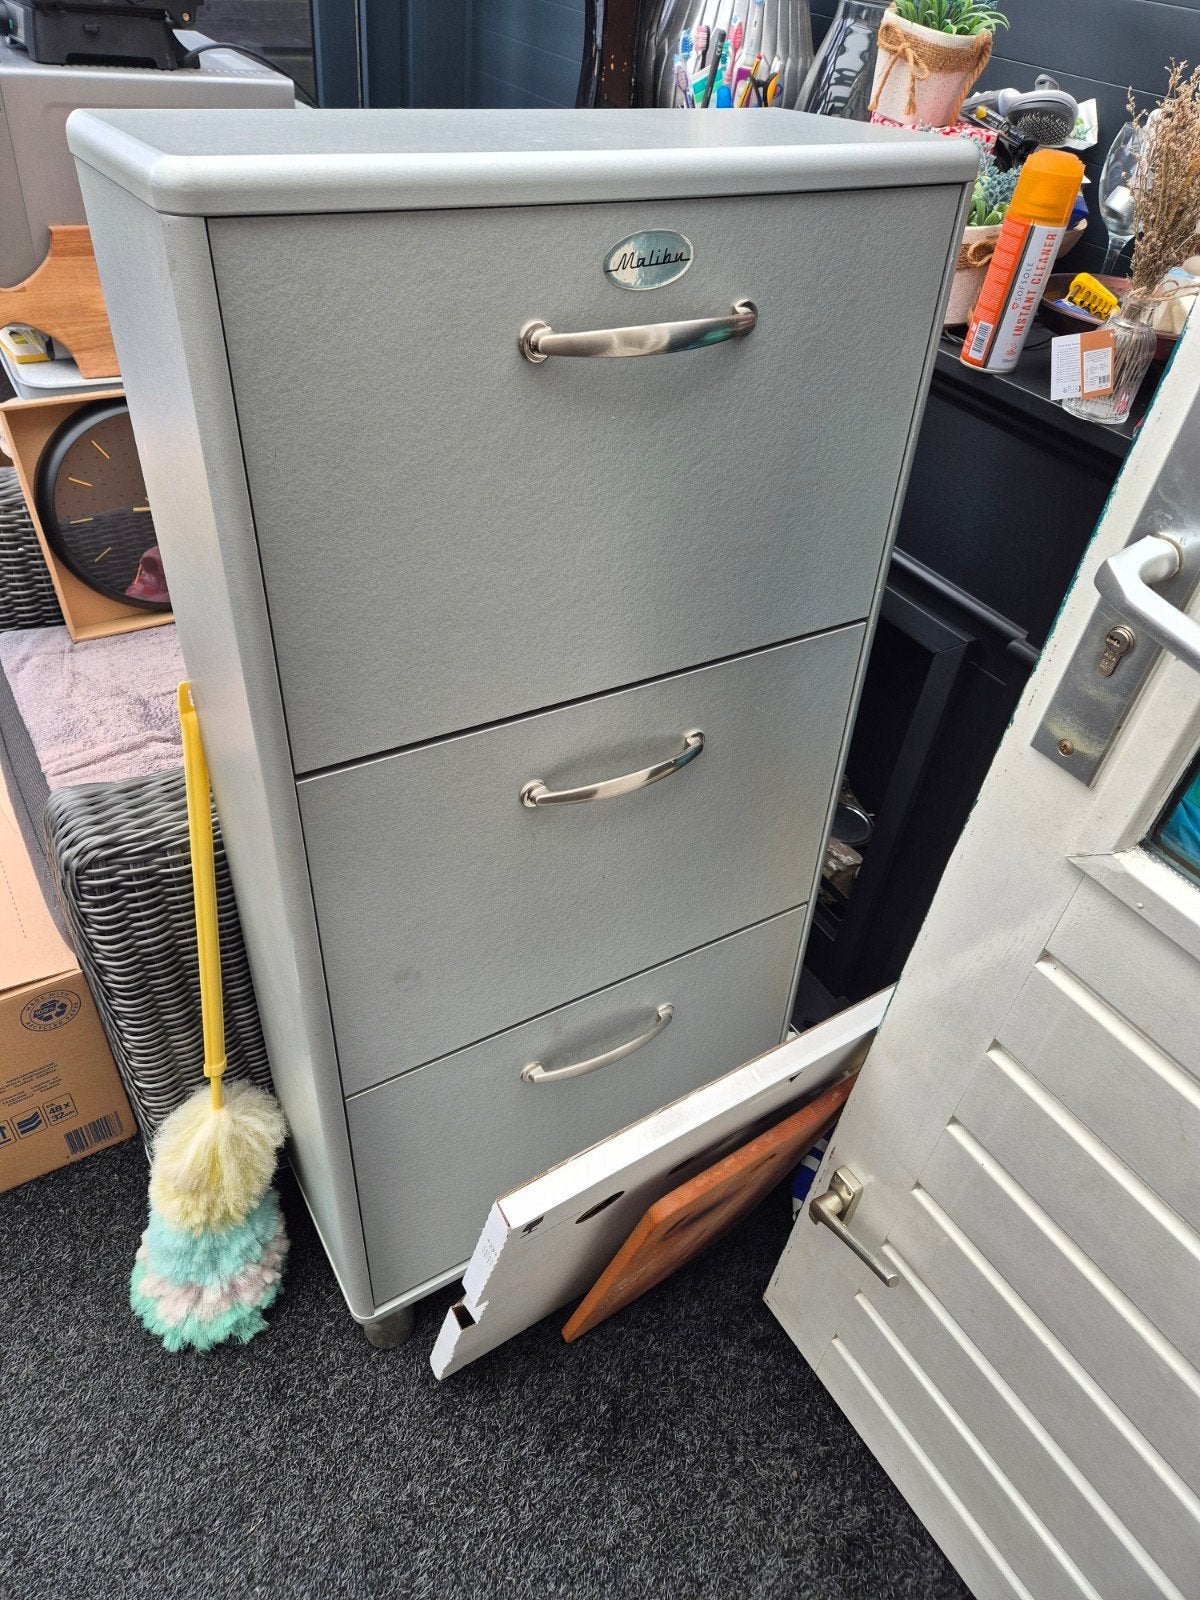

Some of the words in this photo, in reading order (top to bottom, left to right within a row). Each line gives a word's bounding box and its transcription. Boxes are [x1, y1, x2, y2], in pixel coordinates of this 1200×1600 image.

[606, 247, 691, 273] Malibu
[1012, 289, 1037, 337] INSTANT
[1031, 233, 1058, 285] CLEANER
[26, 995, 45, 1012] MADE
[49, 1104, 63, 1115] 48
